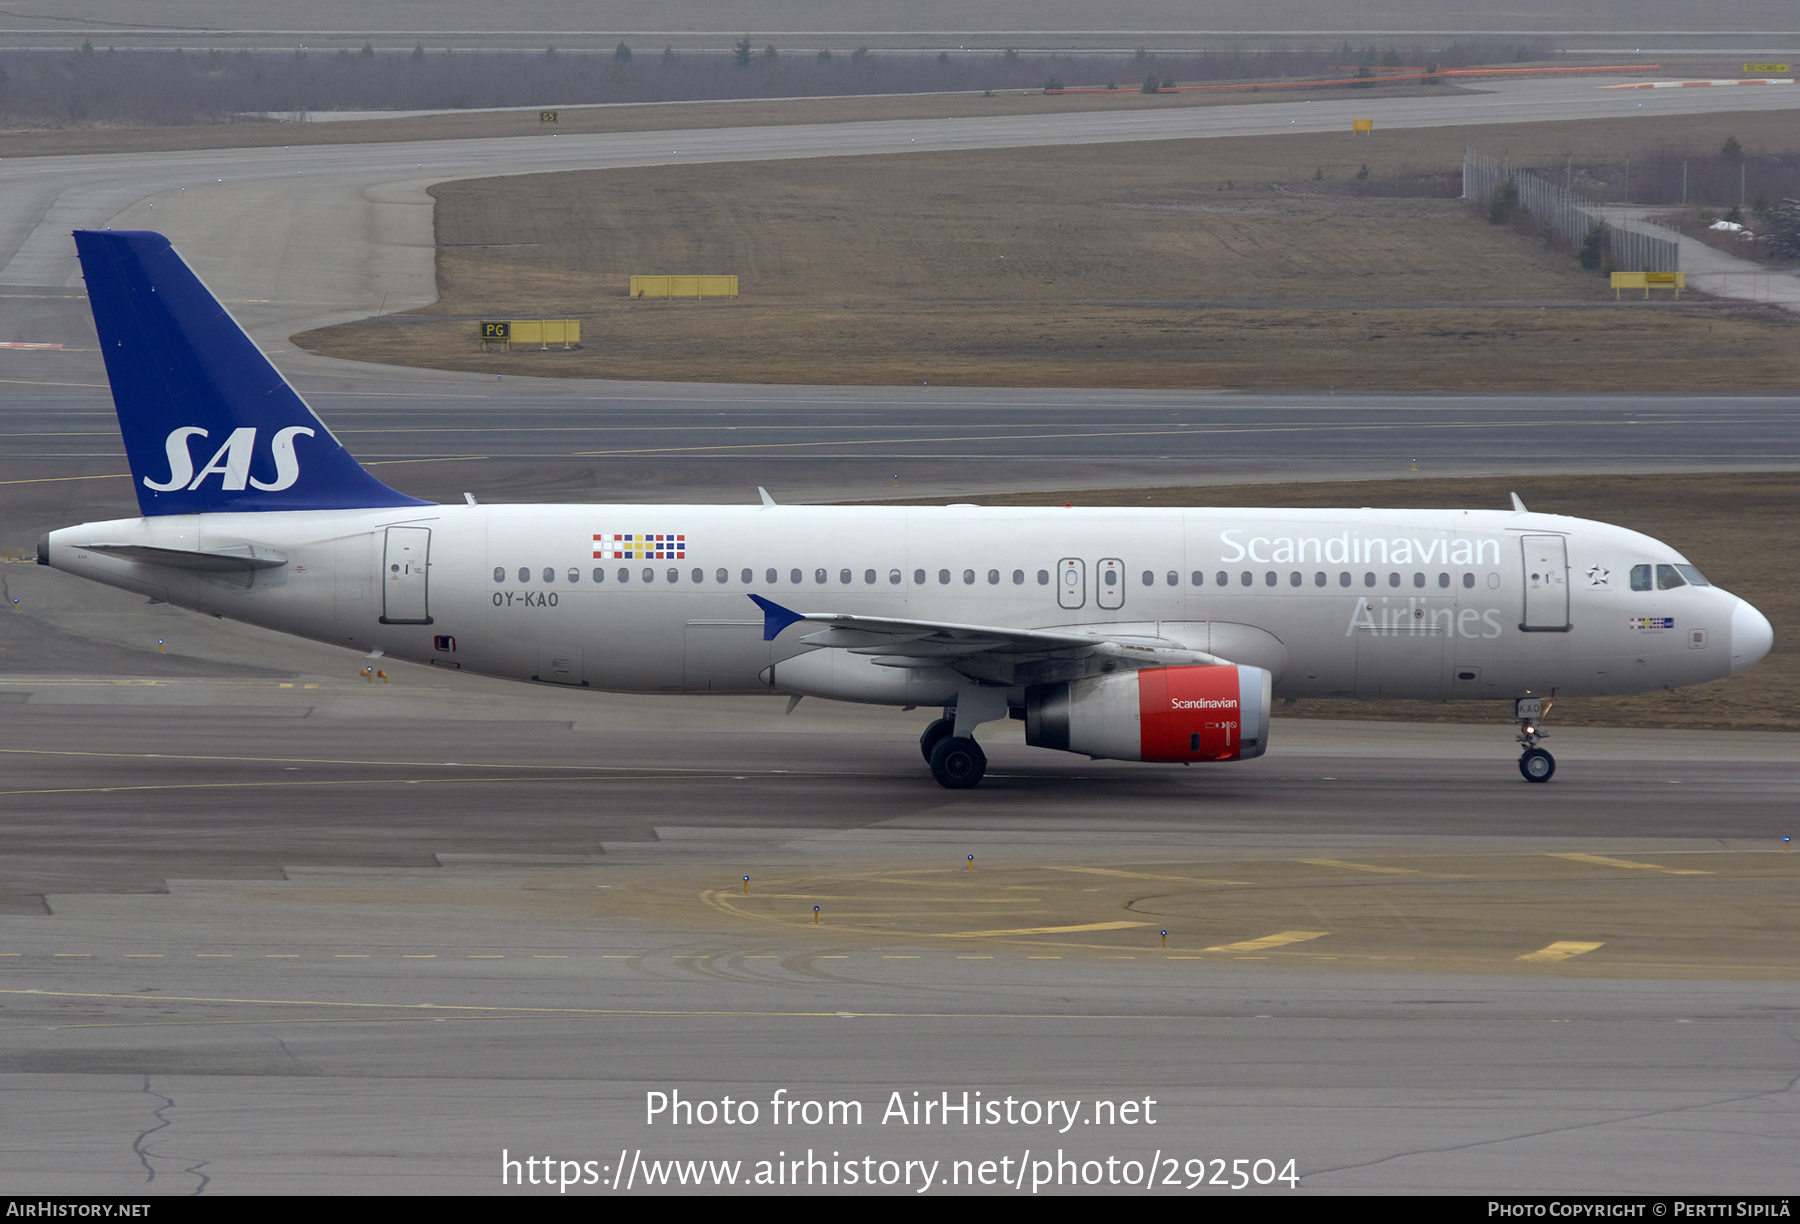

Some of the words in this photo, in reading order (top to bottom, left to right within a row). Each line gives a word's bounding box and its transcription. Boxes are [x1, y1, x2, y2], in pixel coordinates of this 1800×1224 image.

[543, 113, 555, 121] G5
[486, 324, 504, 336] PG
[143, 426, 315, 492] SAS
[1219, 529, 1500, 565] Scandinavian
[492, 592, 558, 607] OY-KAO
[1346, 597, 1502, 639] Airlines
[1171, 697, 1238, 709] Scandinavian
[1520, 704, 1540, 713] KAO
